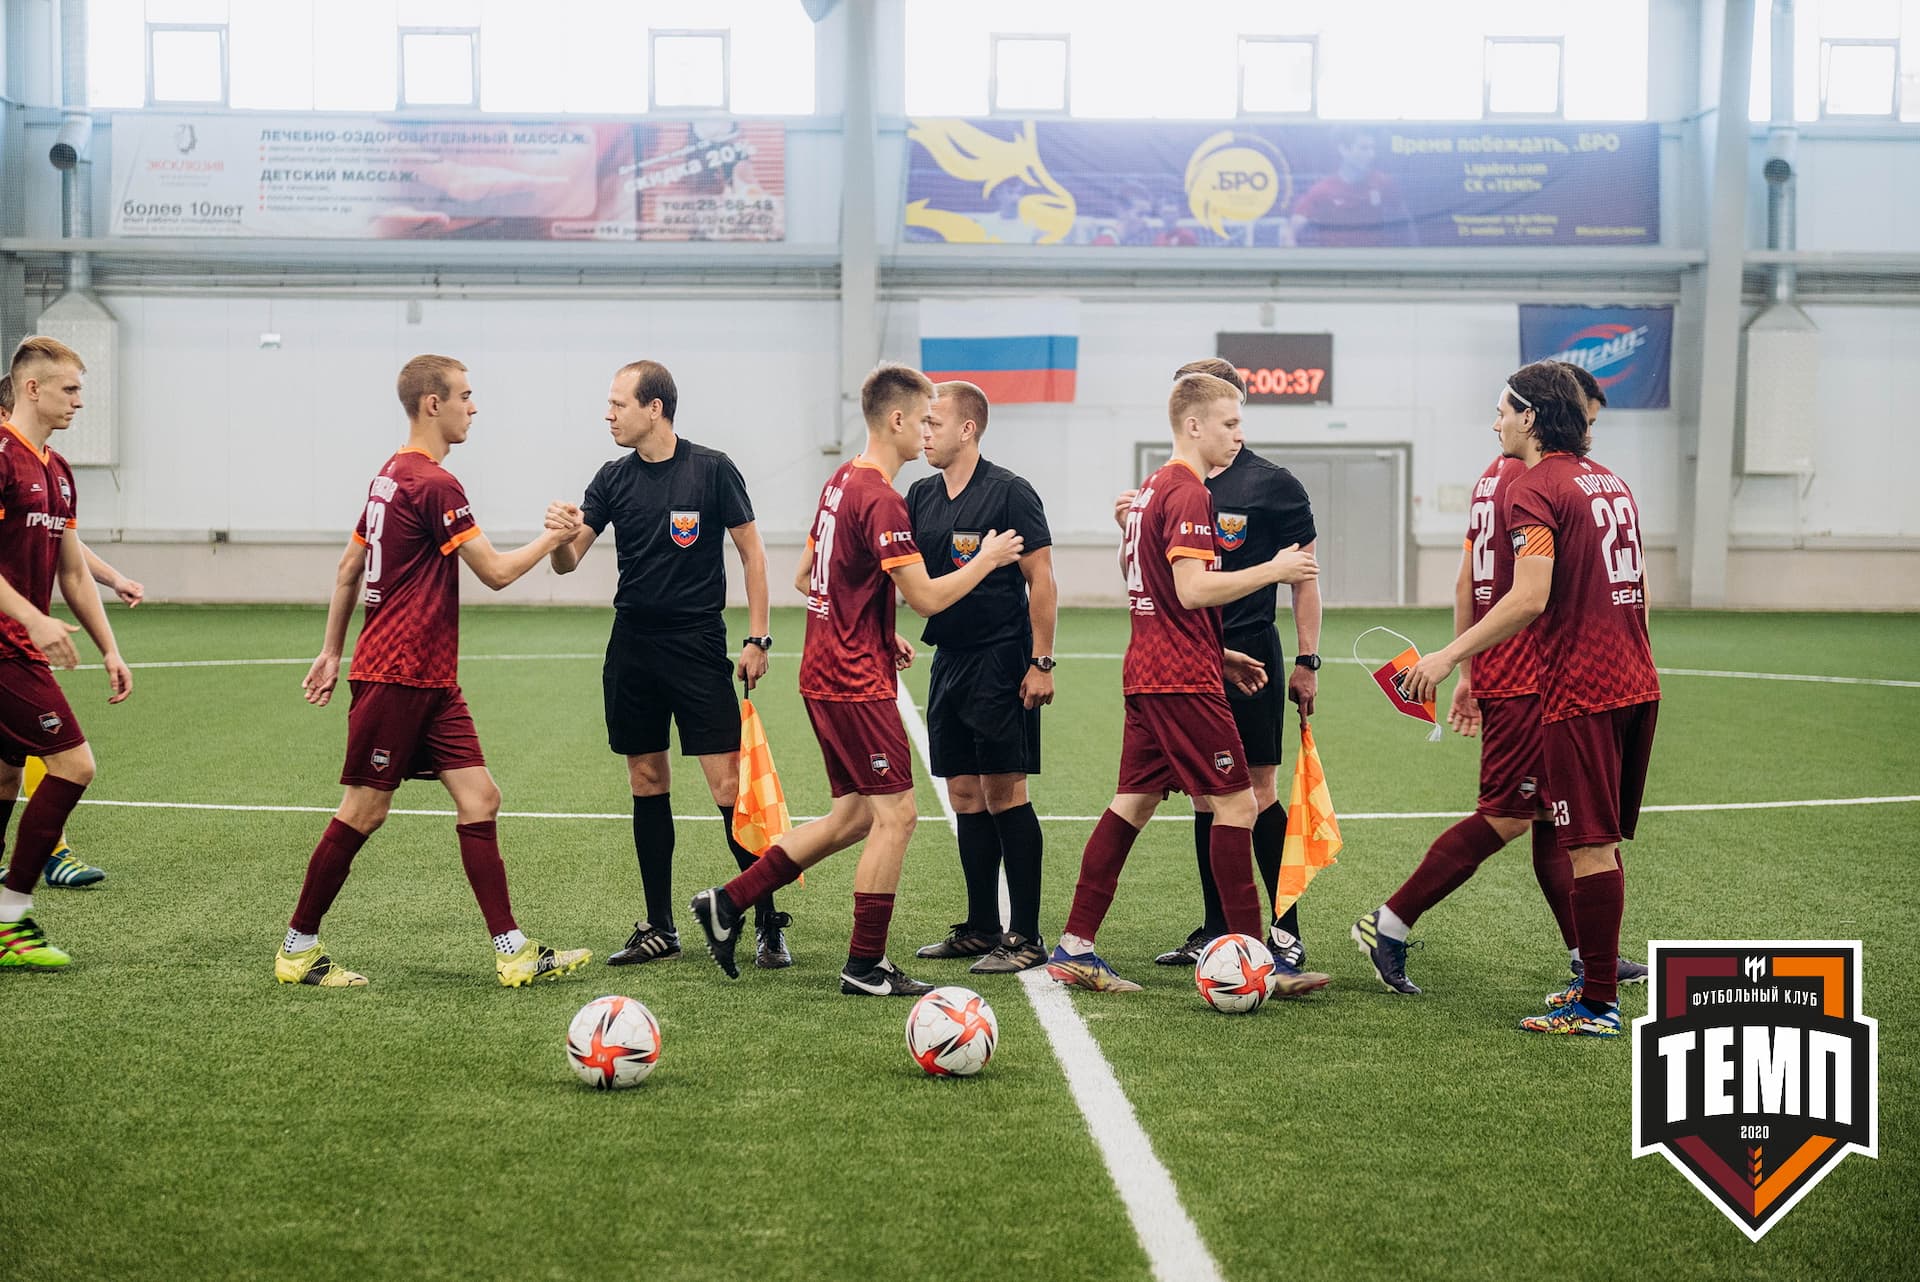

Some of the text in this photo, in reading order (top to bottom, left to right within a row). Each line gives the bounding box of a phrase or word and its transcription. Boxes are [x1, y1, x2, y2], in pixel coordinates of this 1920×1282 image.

[513, 132, 585, 145] МАССАЖ
[261, 168, 336, 184] ДЕТСКИЙ
[124, 200, 244, 216] более 10лет
[1591, 496, 1642, 584] 23
